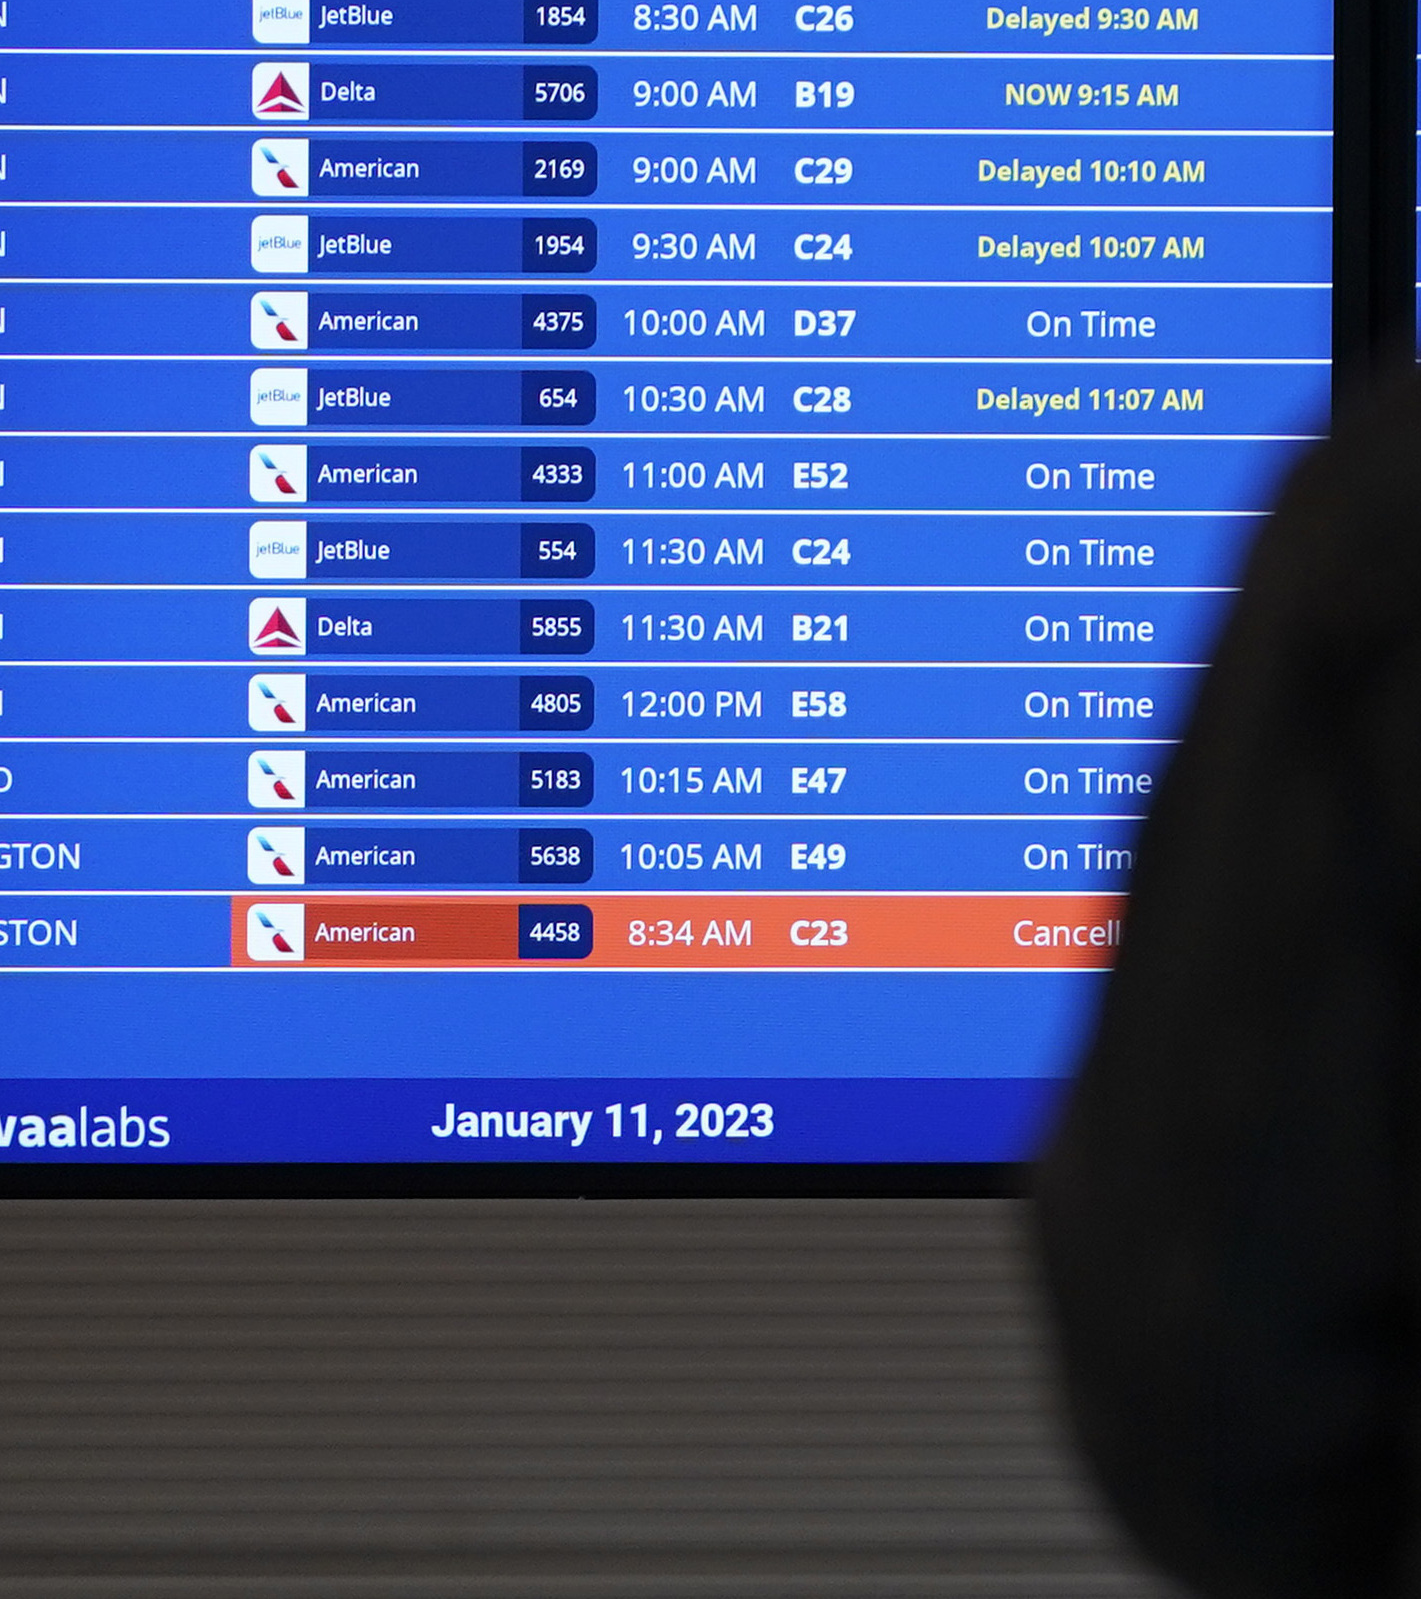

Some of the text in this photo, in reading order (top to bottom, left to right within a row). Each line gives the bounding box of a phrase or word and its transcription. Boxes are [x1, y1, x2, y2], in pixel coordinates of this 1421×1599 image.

[316, 690, 1154, 719] American 4805 12:00 PM E58 On Time
[314, 921, 415, 942] American
[529, 922, 580, 942] 4458
[628, 919, 695, 946] 8:34
[701, 919, 752, 946] AM
[789, 919, 849, 947] C23
[1012, 919, 1121, 947] Cancell
[430, 1102, 775, 1148] January 11, 2023
